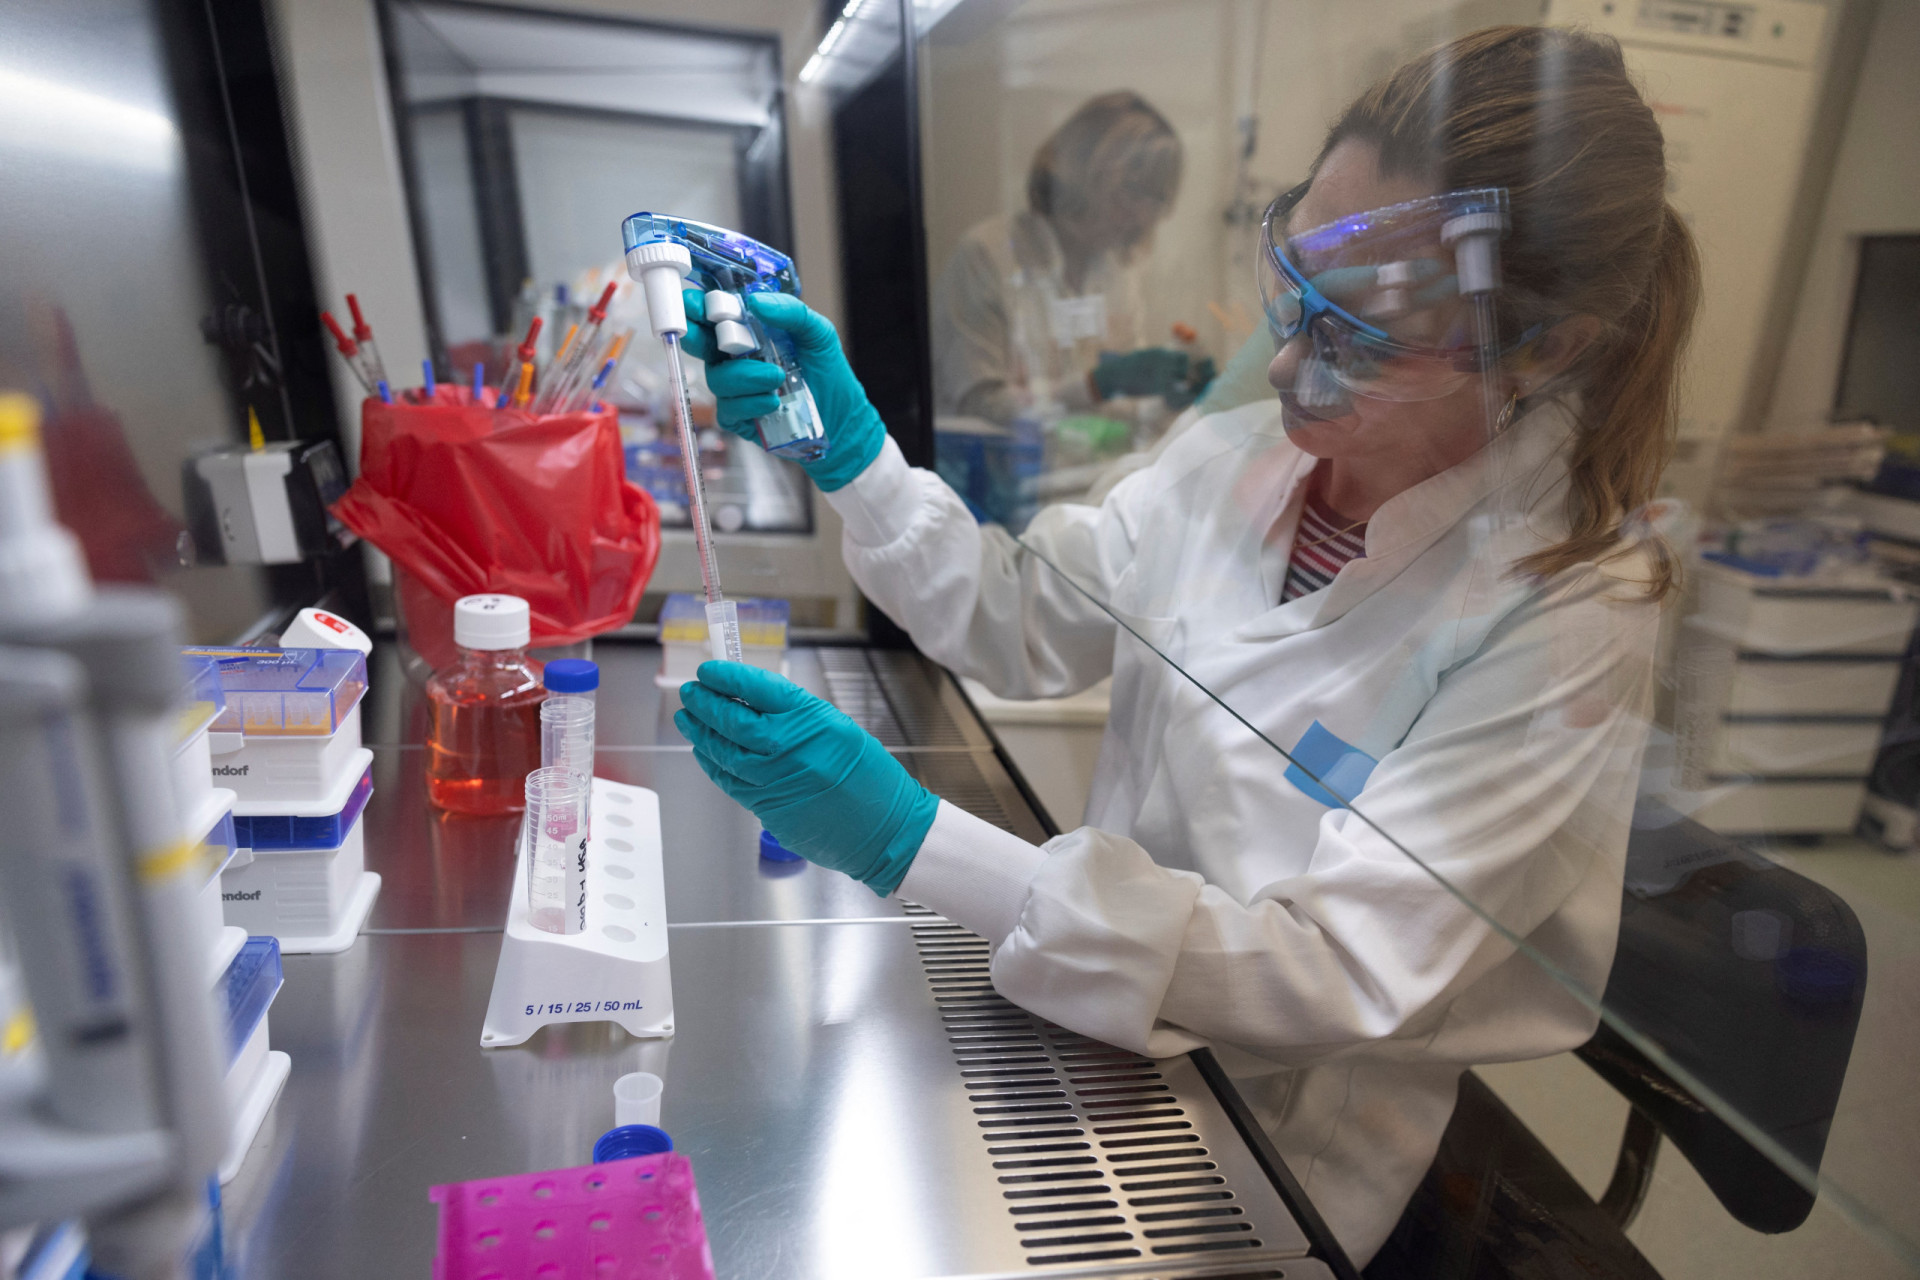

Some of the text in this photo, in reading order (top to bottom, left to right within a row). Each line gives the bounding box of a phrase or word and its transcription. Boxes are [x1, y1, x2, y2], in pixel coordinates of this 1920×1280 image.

[211, 764, 249, 776] ndorf
[525, 999, 643, 1015] 5 / 15 / 25 / 50 mL
